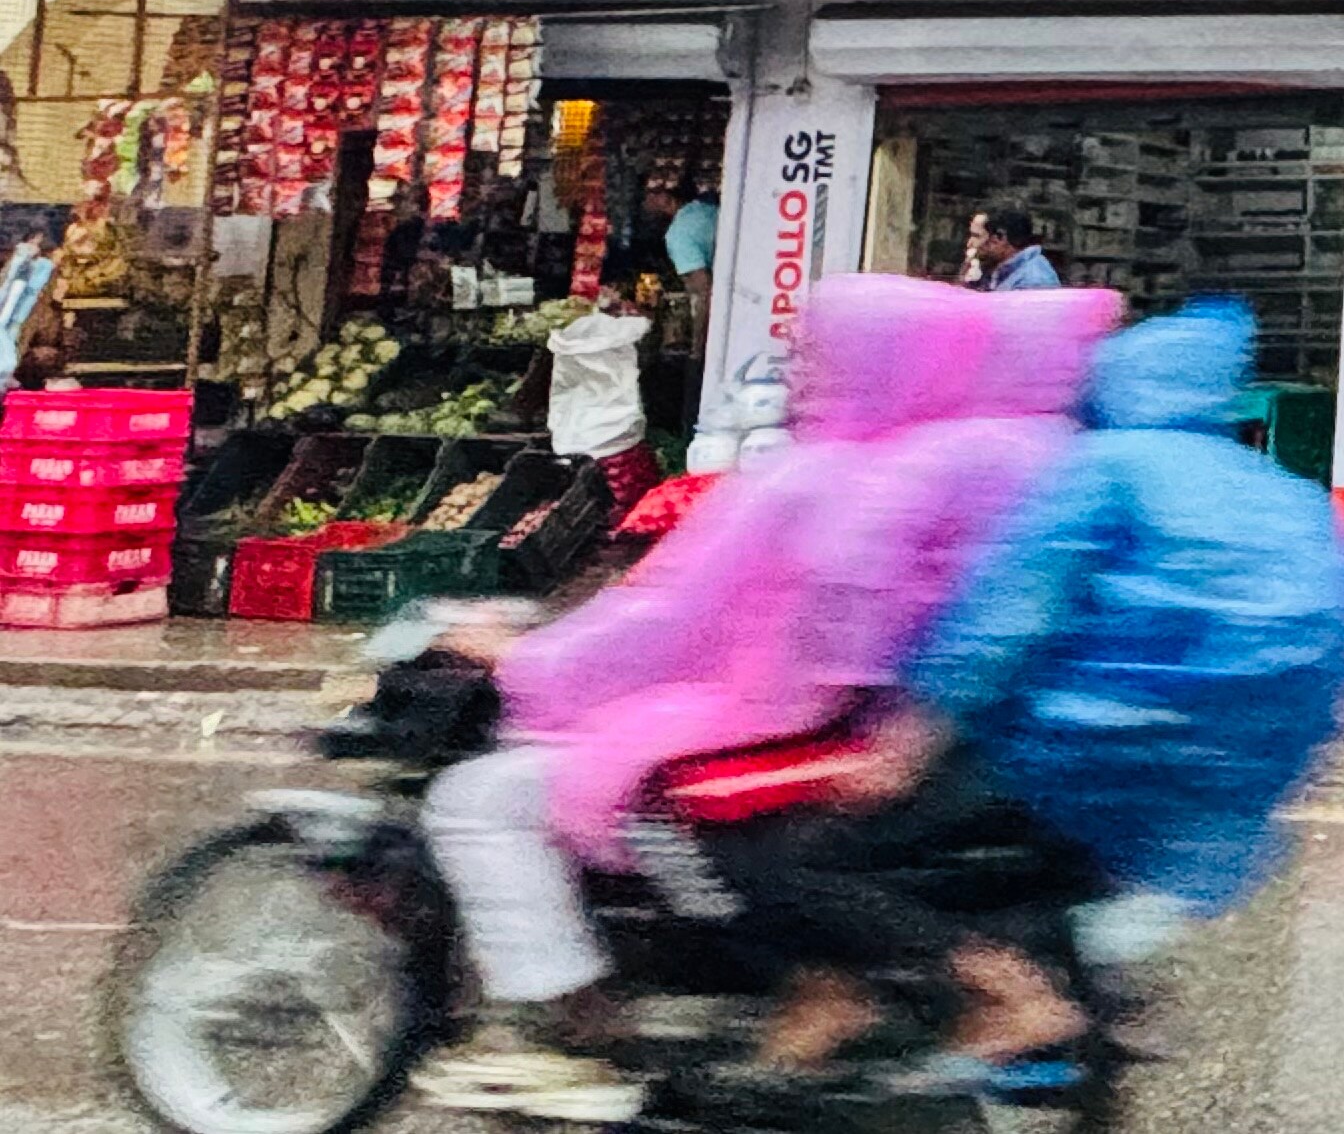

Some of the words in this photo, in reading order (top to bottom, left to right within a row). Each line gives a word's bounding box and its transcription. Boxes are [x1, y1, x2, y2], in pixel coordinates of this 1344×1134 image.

[782, 130, 812, 183] SG
[813, 129, 836, 183] TMT
[769, 190, 808, 342] APOLLO
